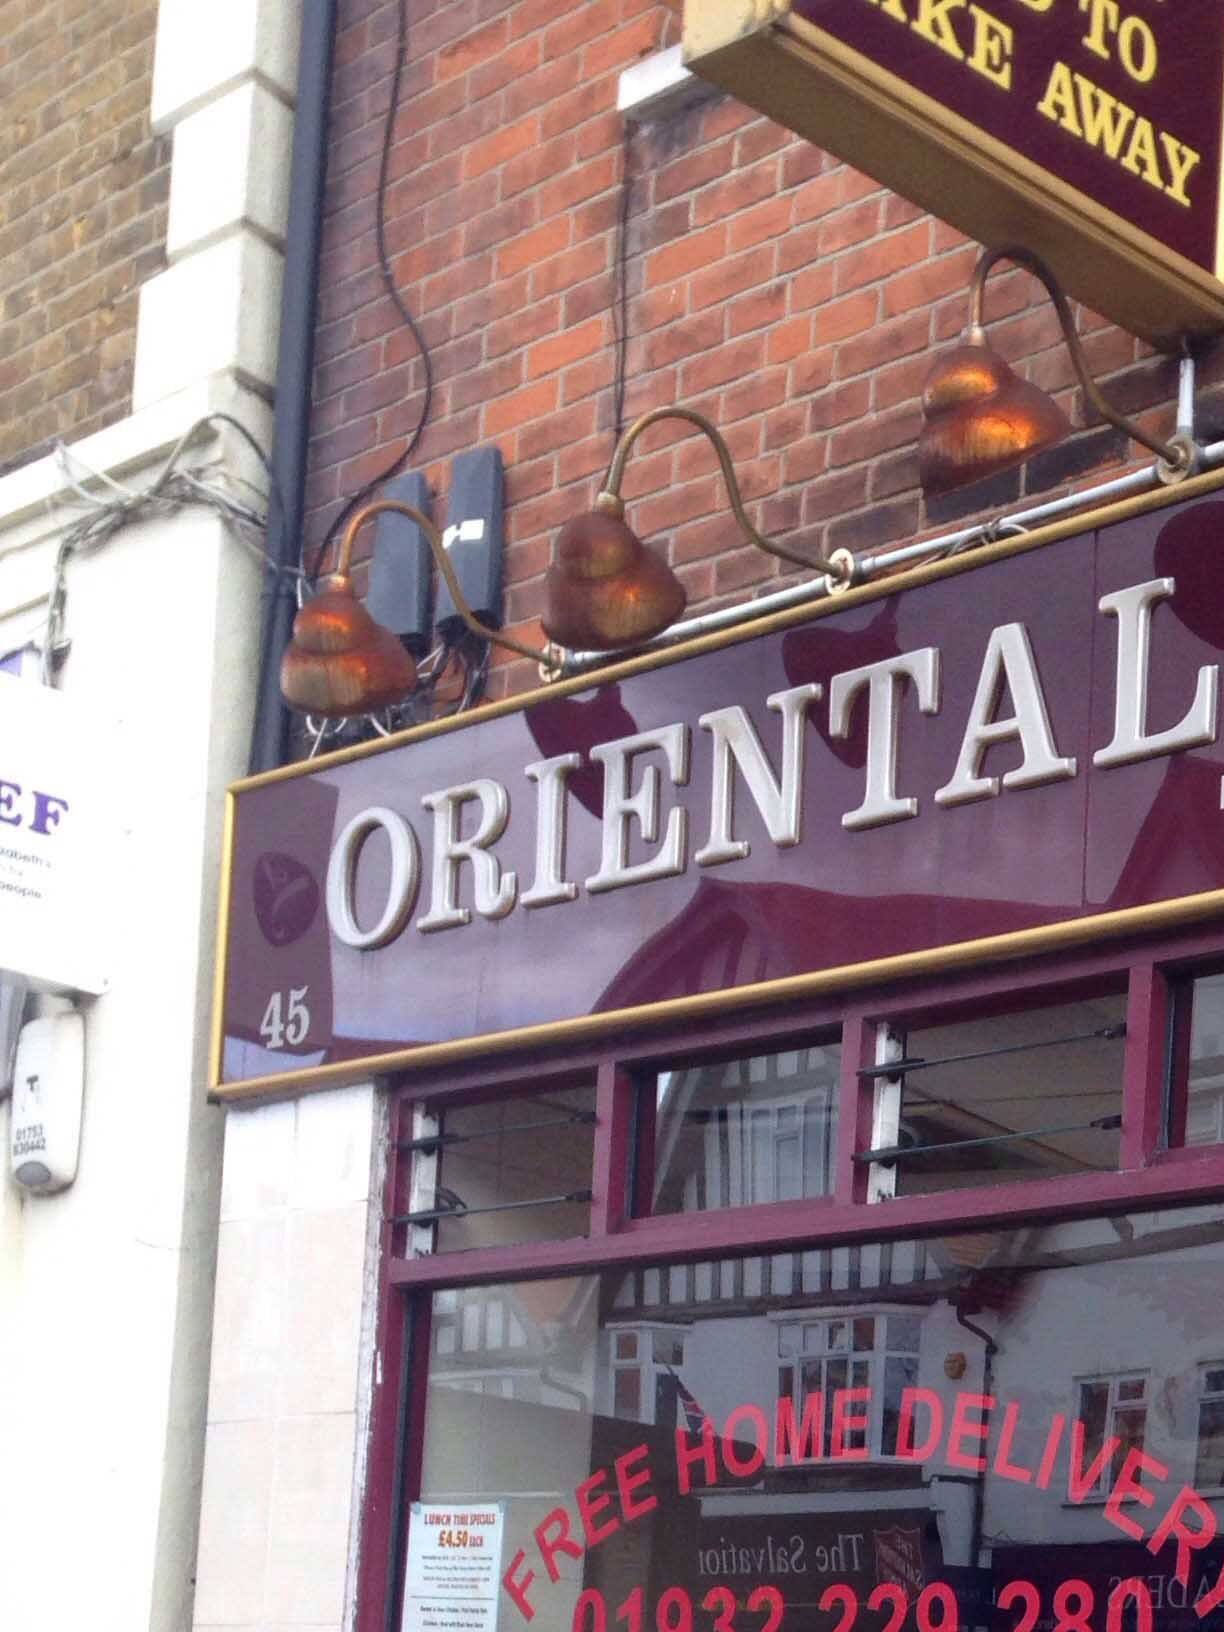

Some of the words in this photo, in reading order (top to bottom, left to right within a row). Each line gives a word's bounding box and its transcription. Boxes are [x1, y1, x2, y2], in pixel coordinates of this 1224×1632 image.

[1079, 0, 1158, 82] TO
[1036, 61, 1201, 207] AWAY
[326, 575, 1221, 951] ORIENTAL
[259, 985, 310, 1049] 45
[424, 1513, 451, 1525] LUNCH
[438, 1530, 469, 1549] £4.50
[502, 1443, 658, 1623] FREE
[675, 1388, 873, 1497] HOME
